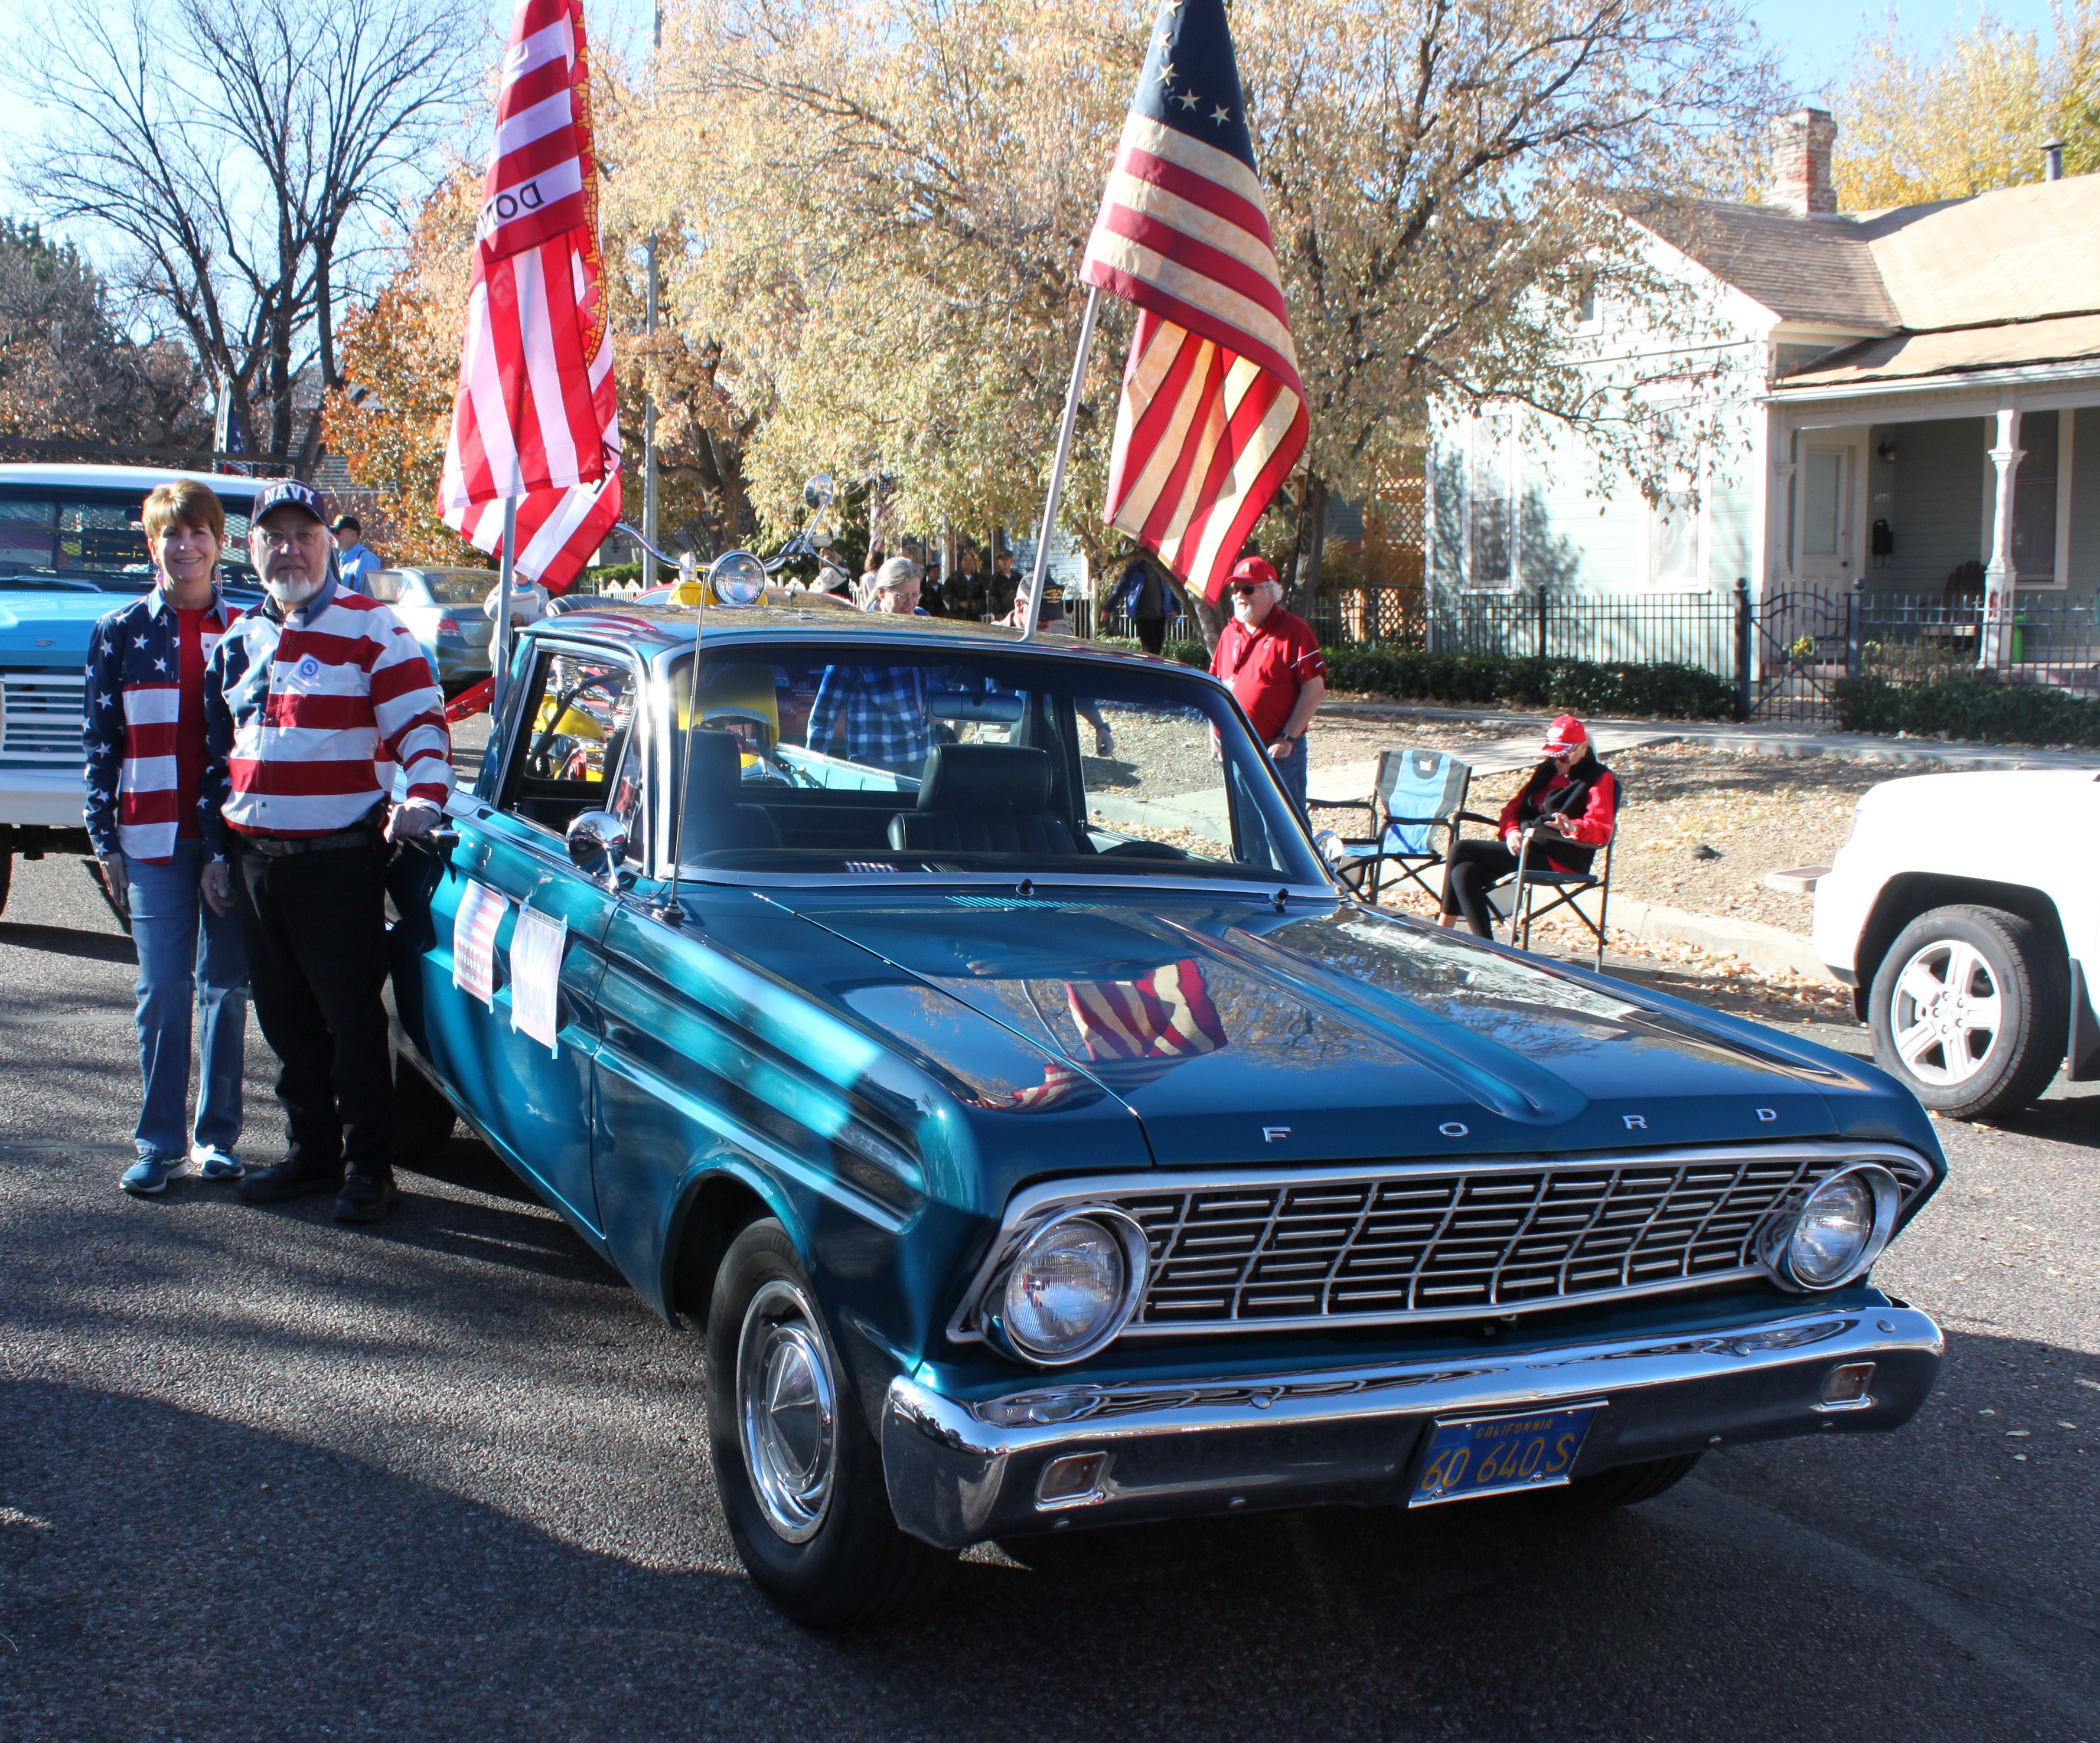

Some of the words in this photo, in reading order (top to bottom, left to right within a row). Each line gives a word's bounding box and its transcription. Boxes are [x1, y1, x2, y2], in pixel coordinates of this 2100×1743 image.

[265, 483, 314, 505] NAVY
[1263, 1109, 1776, 1142] FORD
[1476, 1419, 1553, 1439] CALIFORNIA
